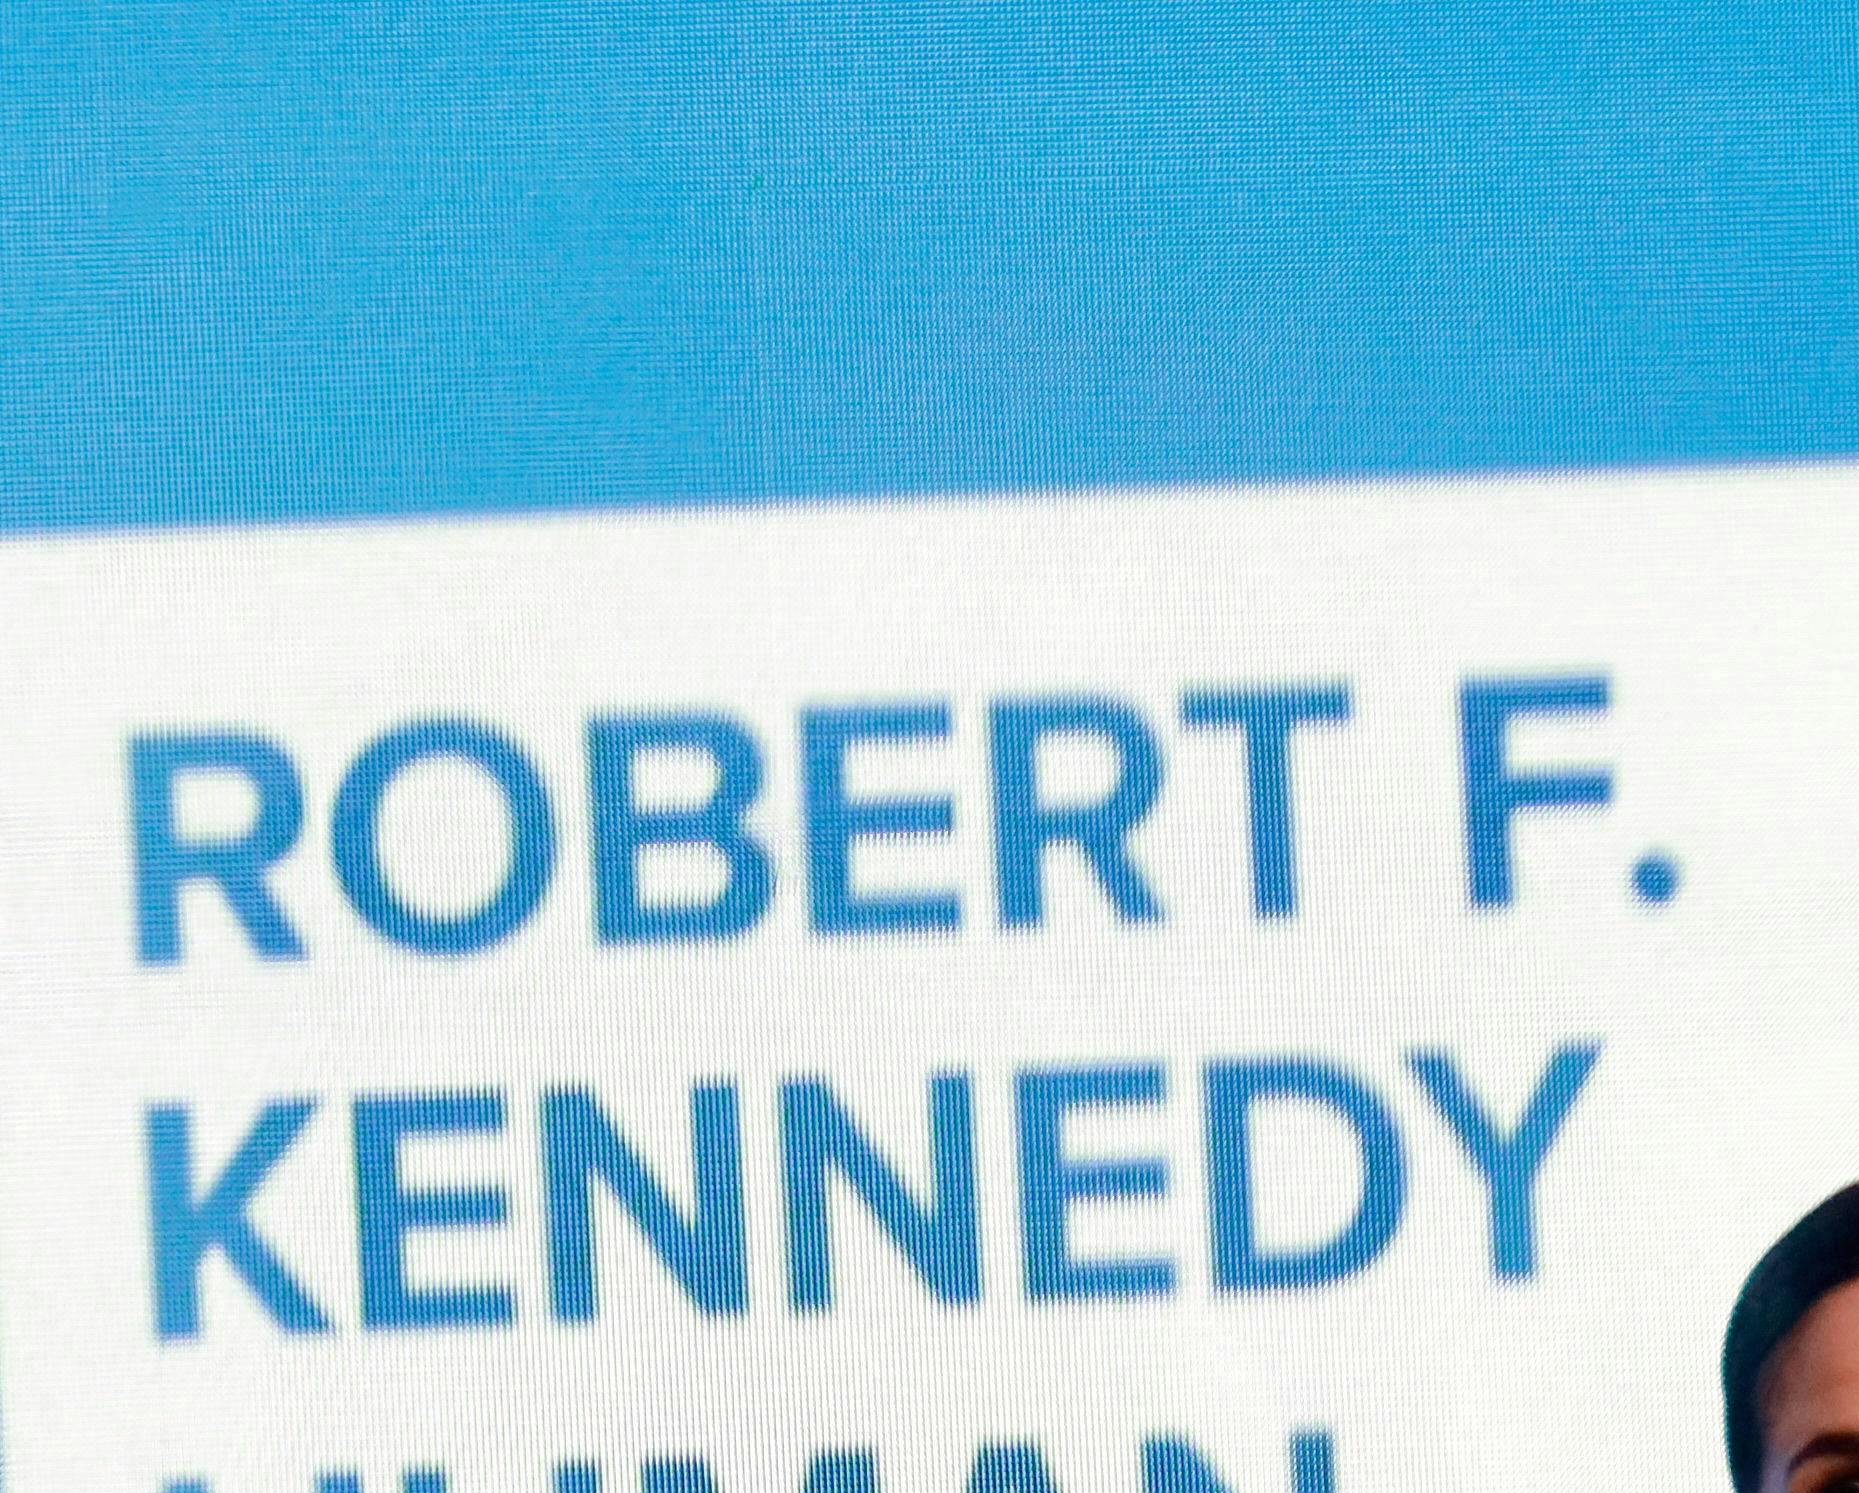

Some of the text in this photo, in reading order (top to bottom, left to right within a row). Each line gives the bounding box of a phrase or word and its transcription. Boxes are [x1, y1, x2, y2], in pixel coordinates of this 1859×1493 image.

[126, 673, 1682, 968] ROBERT F.
[144, 1042, 1602, 1343] KENNEDY
